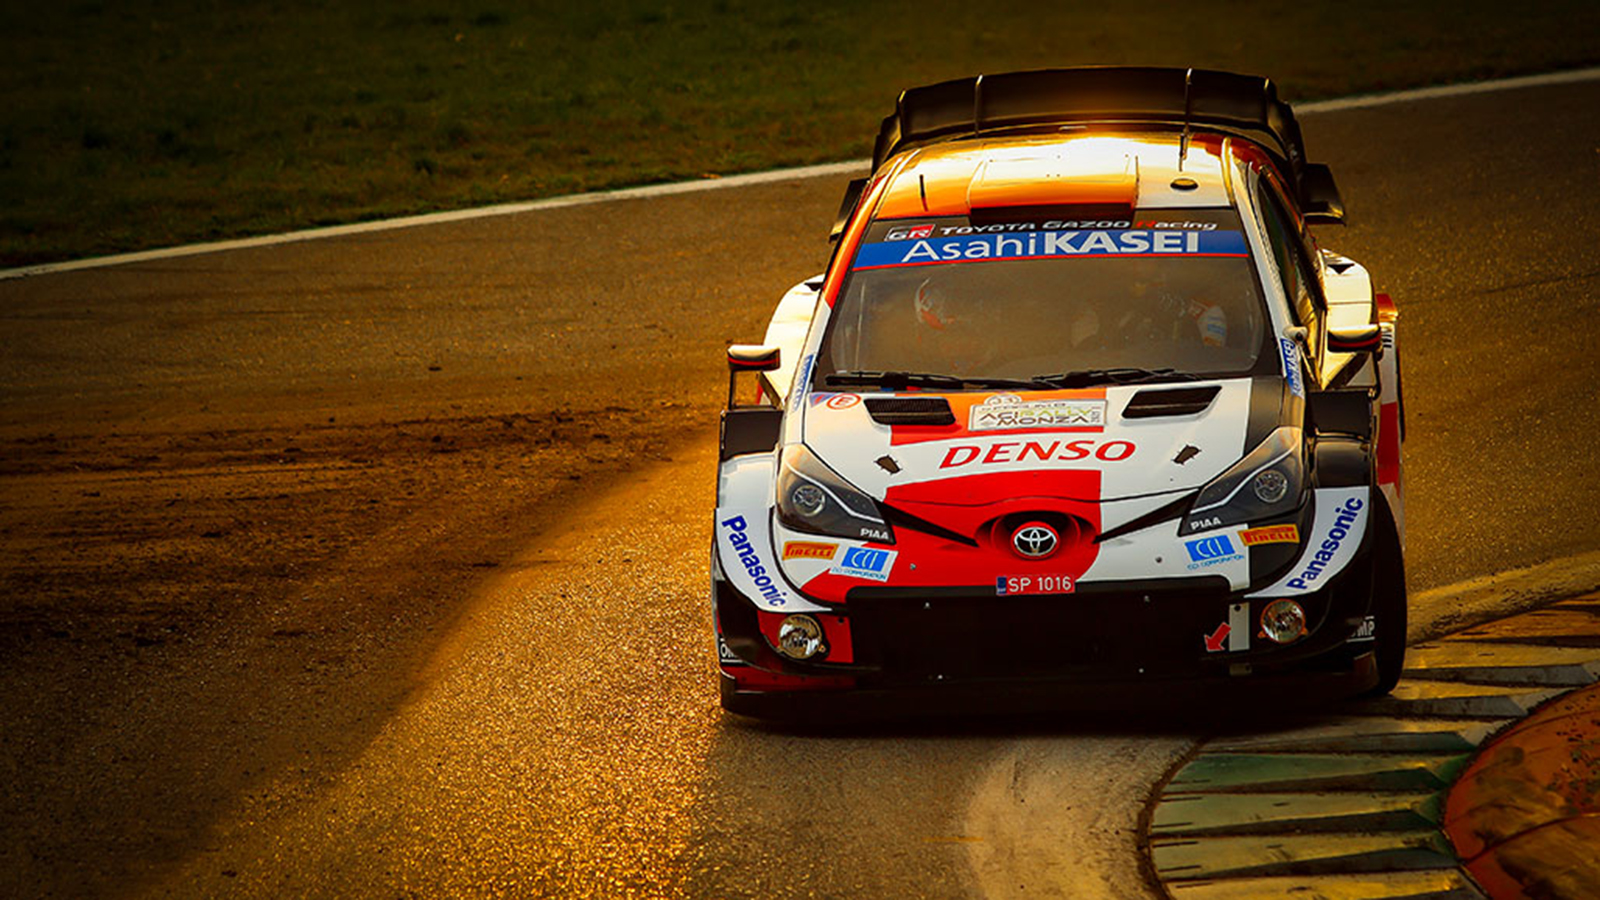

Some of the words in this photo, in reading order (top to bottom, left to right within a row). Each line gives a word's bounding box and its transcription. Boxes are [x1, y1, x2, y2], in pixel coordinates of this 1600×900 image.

[888, 227, 931, 240] GR
[940, 222, 1036, 236] TOYOTA
[1042, 219, 1131, 230] GAZOO
[1136, 220, 1218, 232] Racing
[996, 415, 1090, 427] MONZA
[939, 440, 1137, 469] DENSO
[1190, 516, 1222, 530] PIAA
[860, 528, 889, 540] PIAA
[1243, 526, 1296, 544] PIRELLI
[784, 542, 836, 558] PIRELLI
[1285, 498, 1364, 590] Panasonic
[721, 514, 788, 607] Panasonic
[1008, 577, 1031, 592] SP
[1037, 576, 1072, 591] 1016
[1351, 620, 1375, 637] MP
